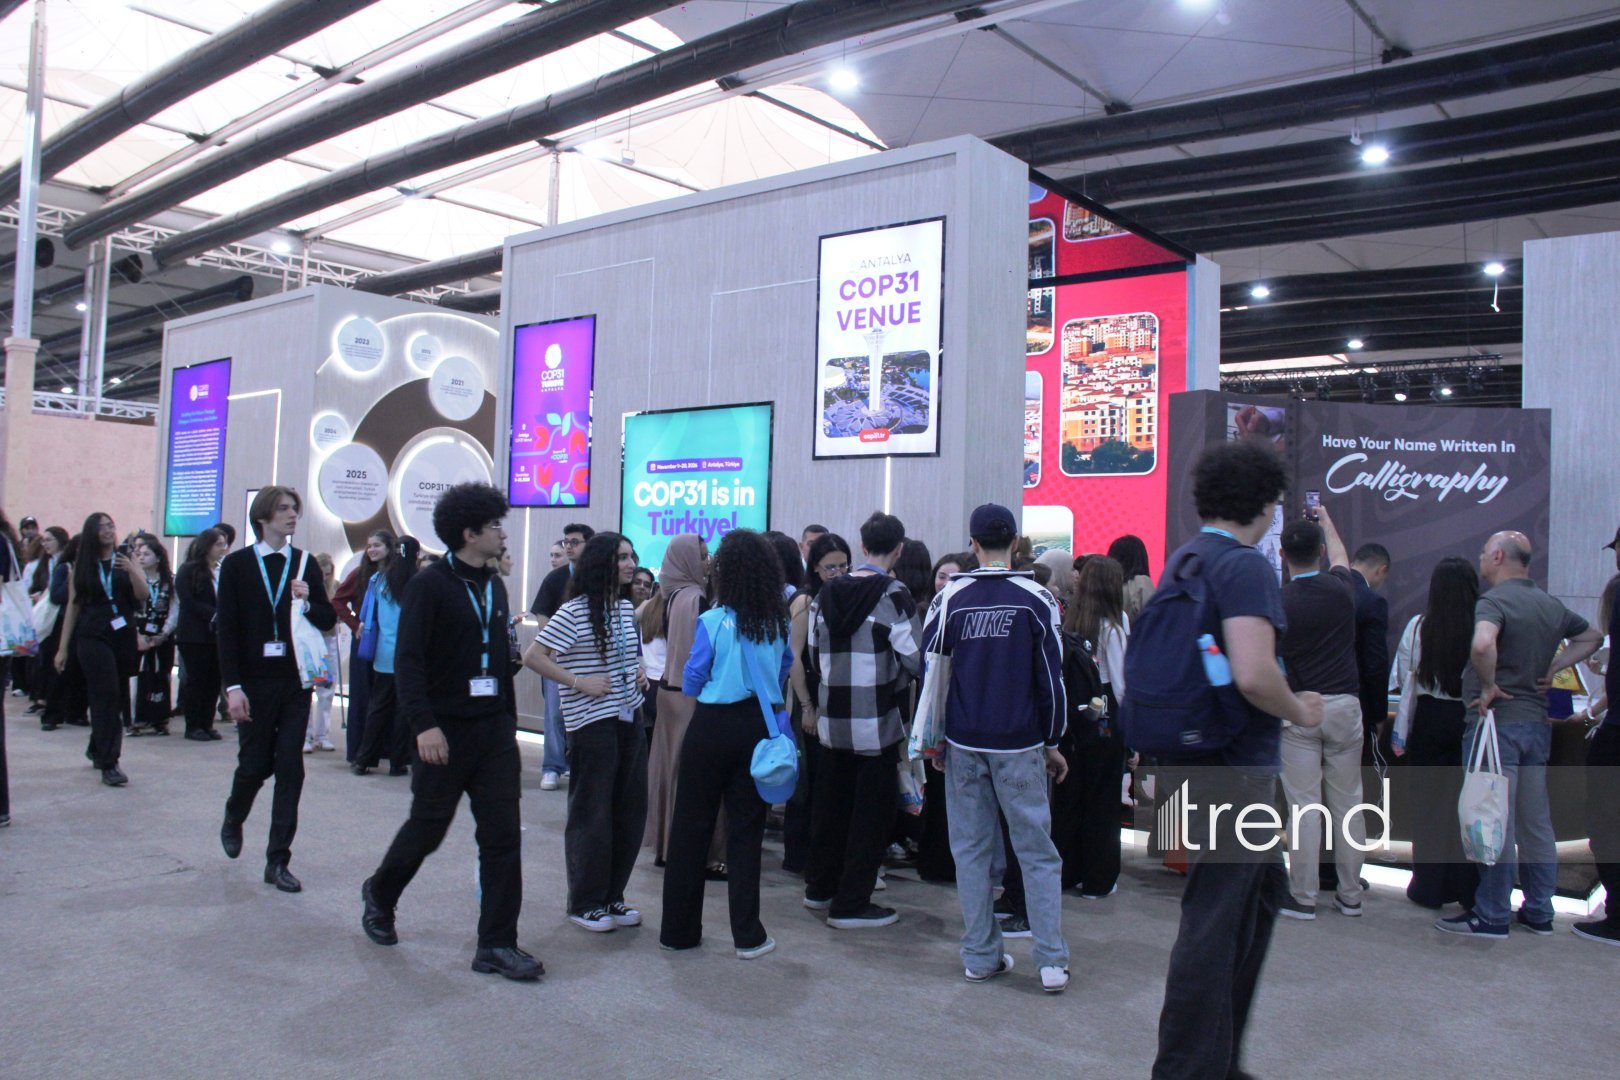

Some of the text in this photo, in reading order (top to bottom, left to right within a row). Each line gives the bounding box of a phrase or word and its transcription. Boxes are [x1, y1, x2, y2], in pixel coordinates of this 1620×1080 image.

[859, 252, 912, 270] ANTALYA
[839, 270, 919, 301] COP31
[836, 301, 921, 331] VENUE
[1322, 435, 1516, 453] Have Your Name Written In
[345, 469, 367, 480] 2025
[418, 481, 444, 491] COP31
[1325, 452, 1509, 504] Calligraphy
[633, 477, 755, 507] COP31 is in
[647, 510, 737, 543] Türkiye!
[960, 609, 1017, 641] NIKE
